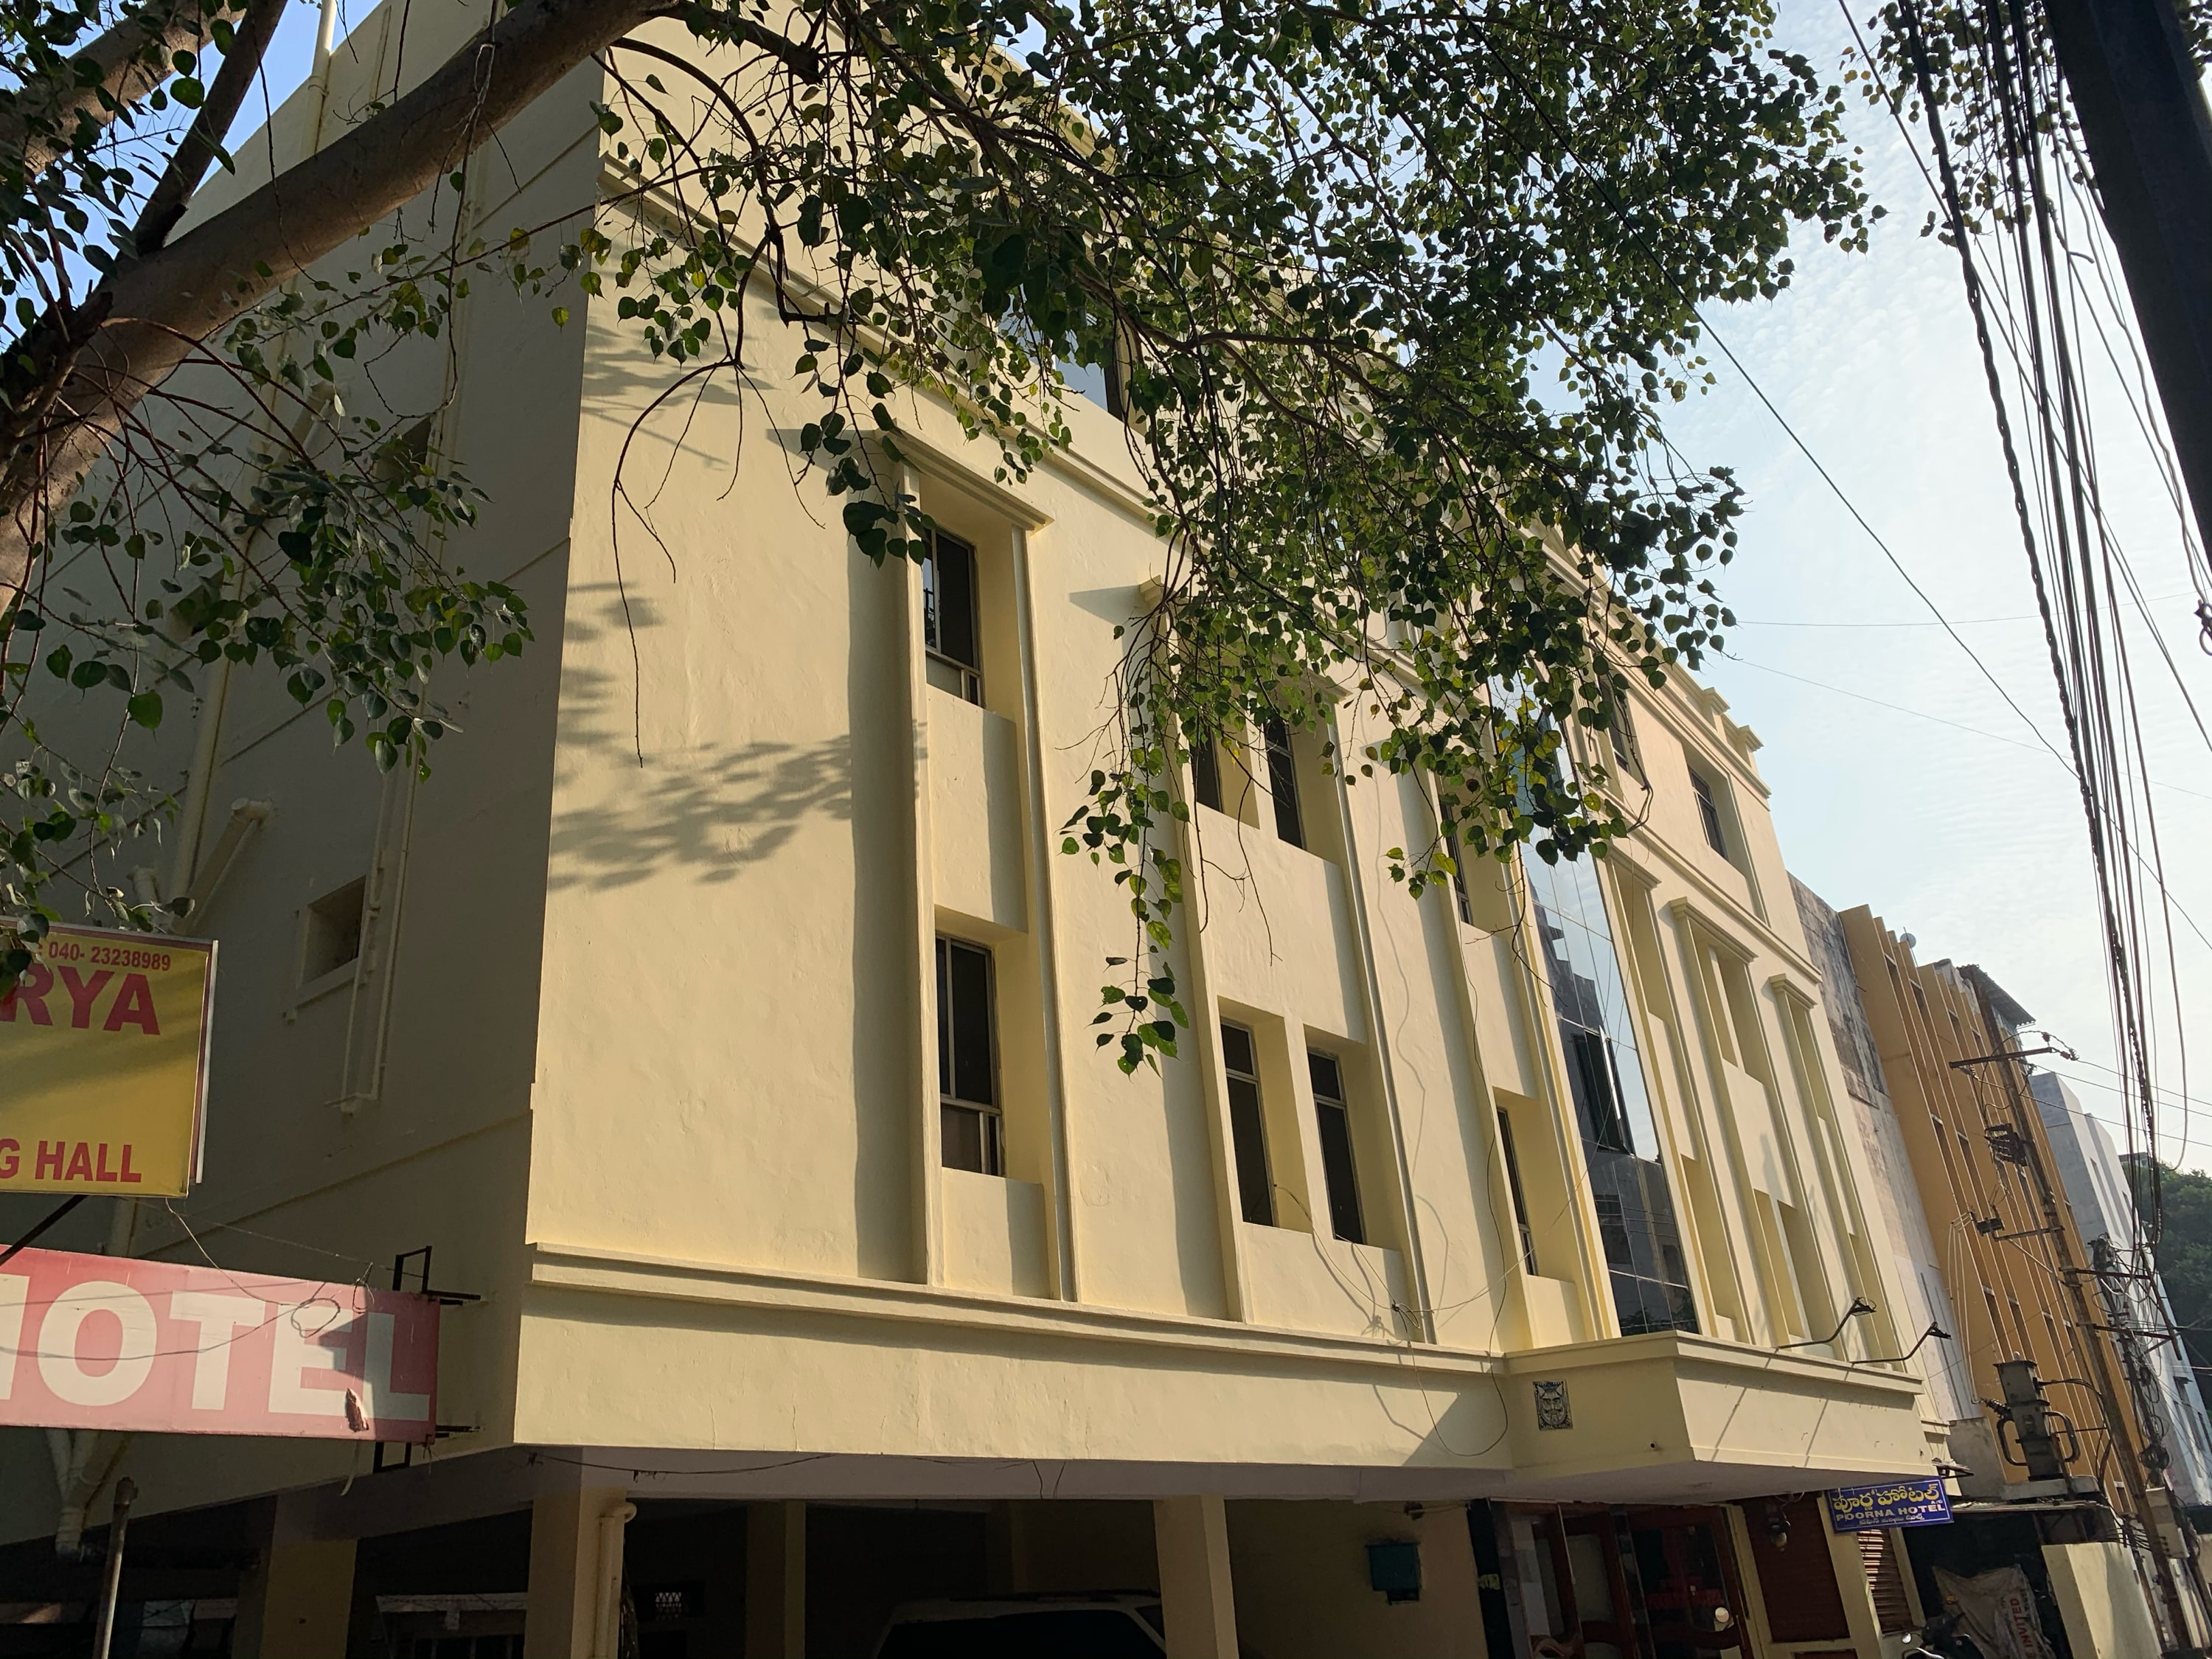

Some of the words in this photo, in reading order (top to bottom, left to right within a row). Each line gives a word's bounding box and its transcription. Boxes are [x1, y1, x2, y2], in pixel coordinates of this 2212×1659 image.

[90, 945, 171, 971] 23238989
[35, 1140, 142, 1183] HALL
[1877, 1484, 1939, 1506] హోటల్
[1836, 1509, 1895, 1522] POORNA
[1898, 1504, 1946, 1515] HOTEL
[2009, 1598, 2034, 1647] INVITED
